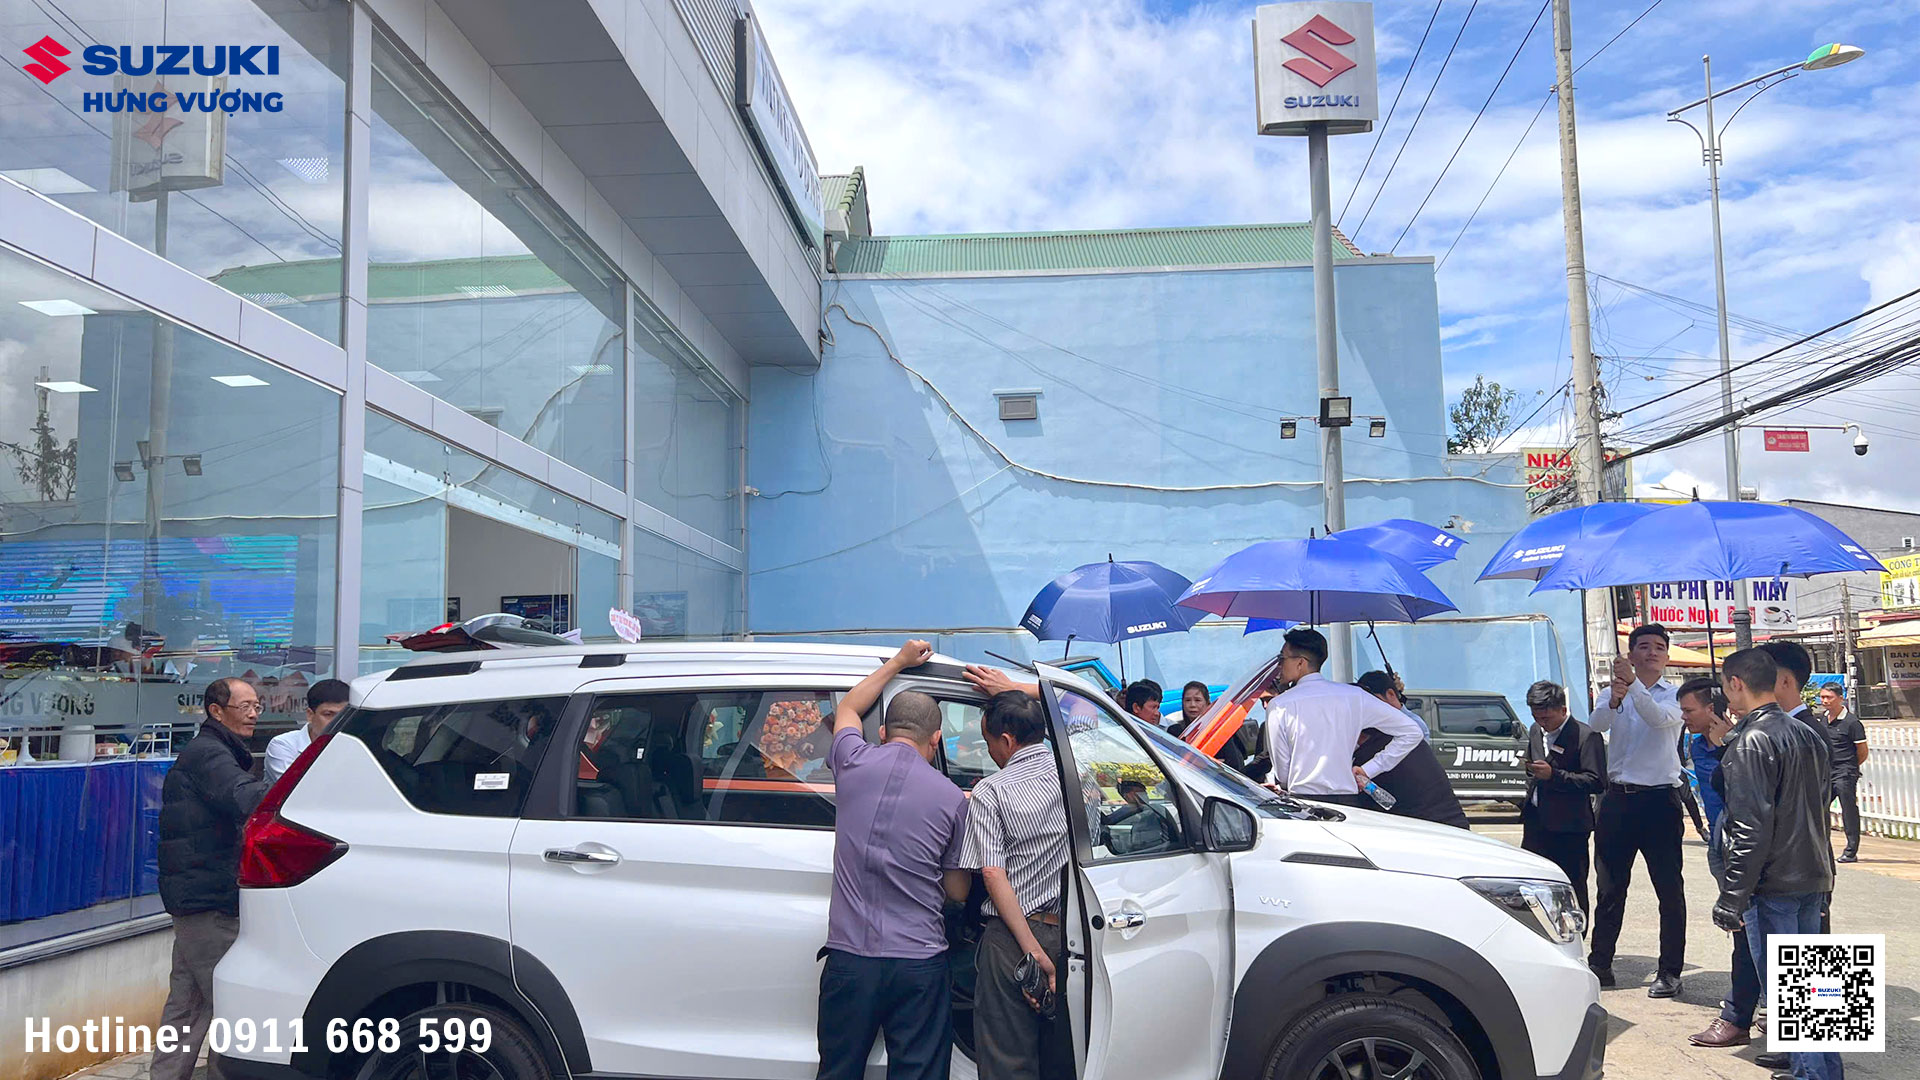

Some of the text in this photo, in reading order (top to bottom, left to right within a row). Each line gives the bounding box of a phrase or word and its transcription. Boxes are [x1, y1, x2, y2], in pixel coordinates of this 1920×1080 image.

[1284, 95, 1359, 109] SUZUKI
[1127, 621, 1168, 634] SUZUKI
[1453, 746, 1525, 767] Jimny
[1259, 895, 1291, 908] VVT
